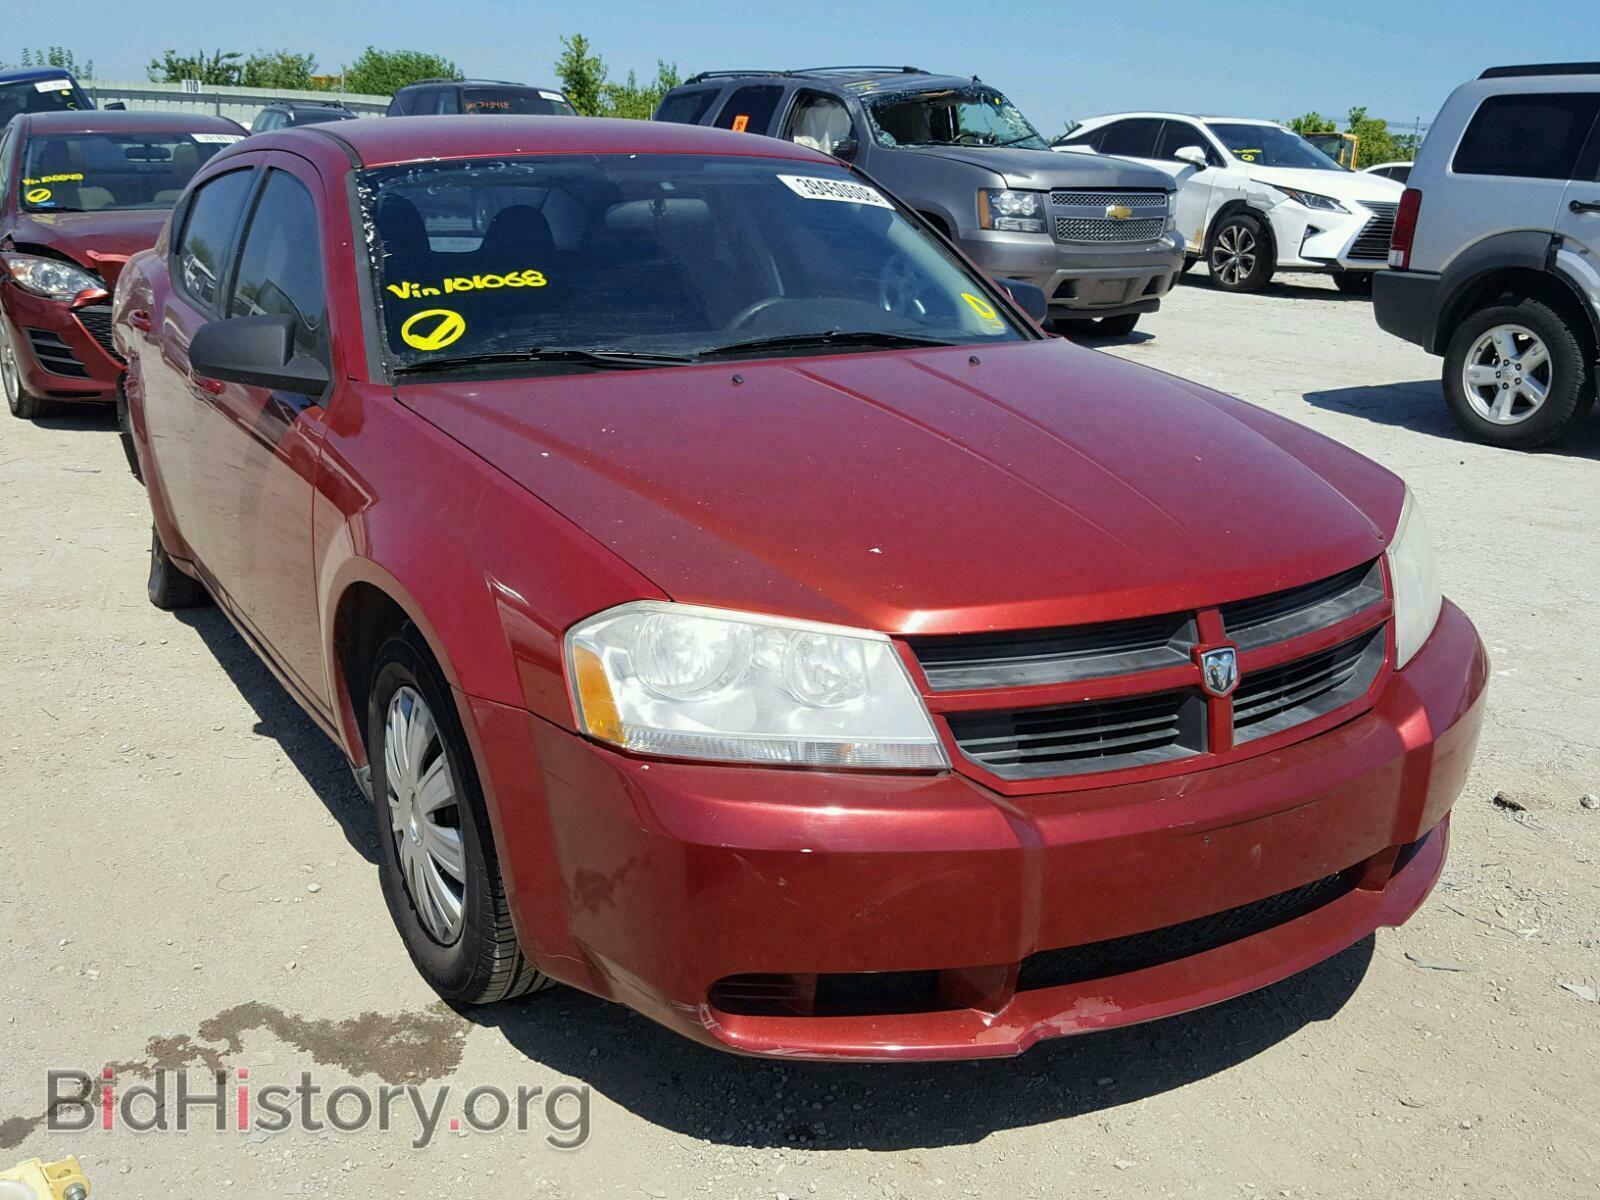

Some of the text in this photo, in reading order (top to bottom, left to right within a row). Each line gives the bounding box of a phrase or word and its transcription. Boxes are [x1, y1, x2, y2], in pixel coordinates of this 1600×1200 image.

[185, 80, 199, 93] 110
[796, 178, 879, 203] 39450608
[386, 269, 547, 299] Vin 101068
